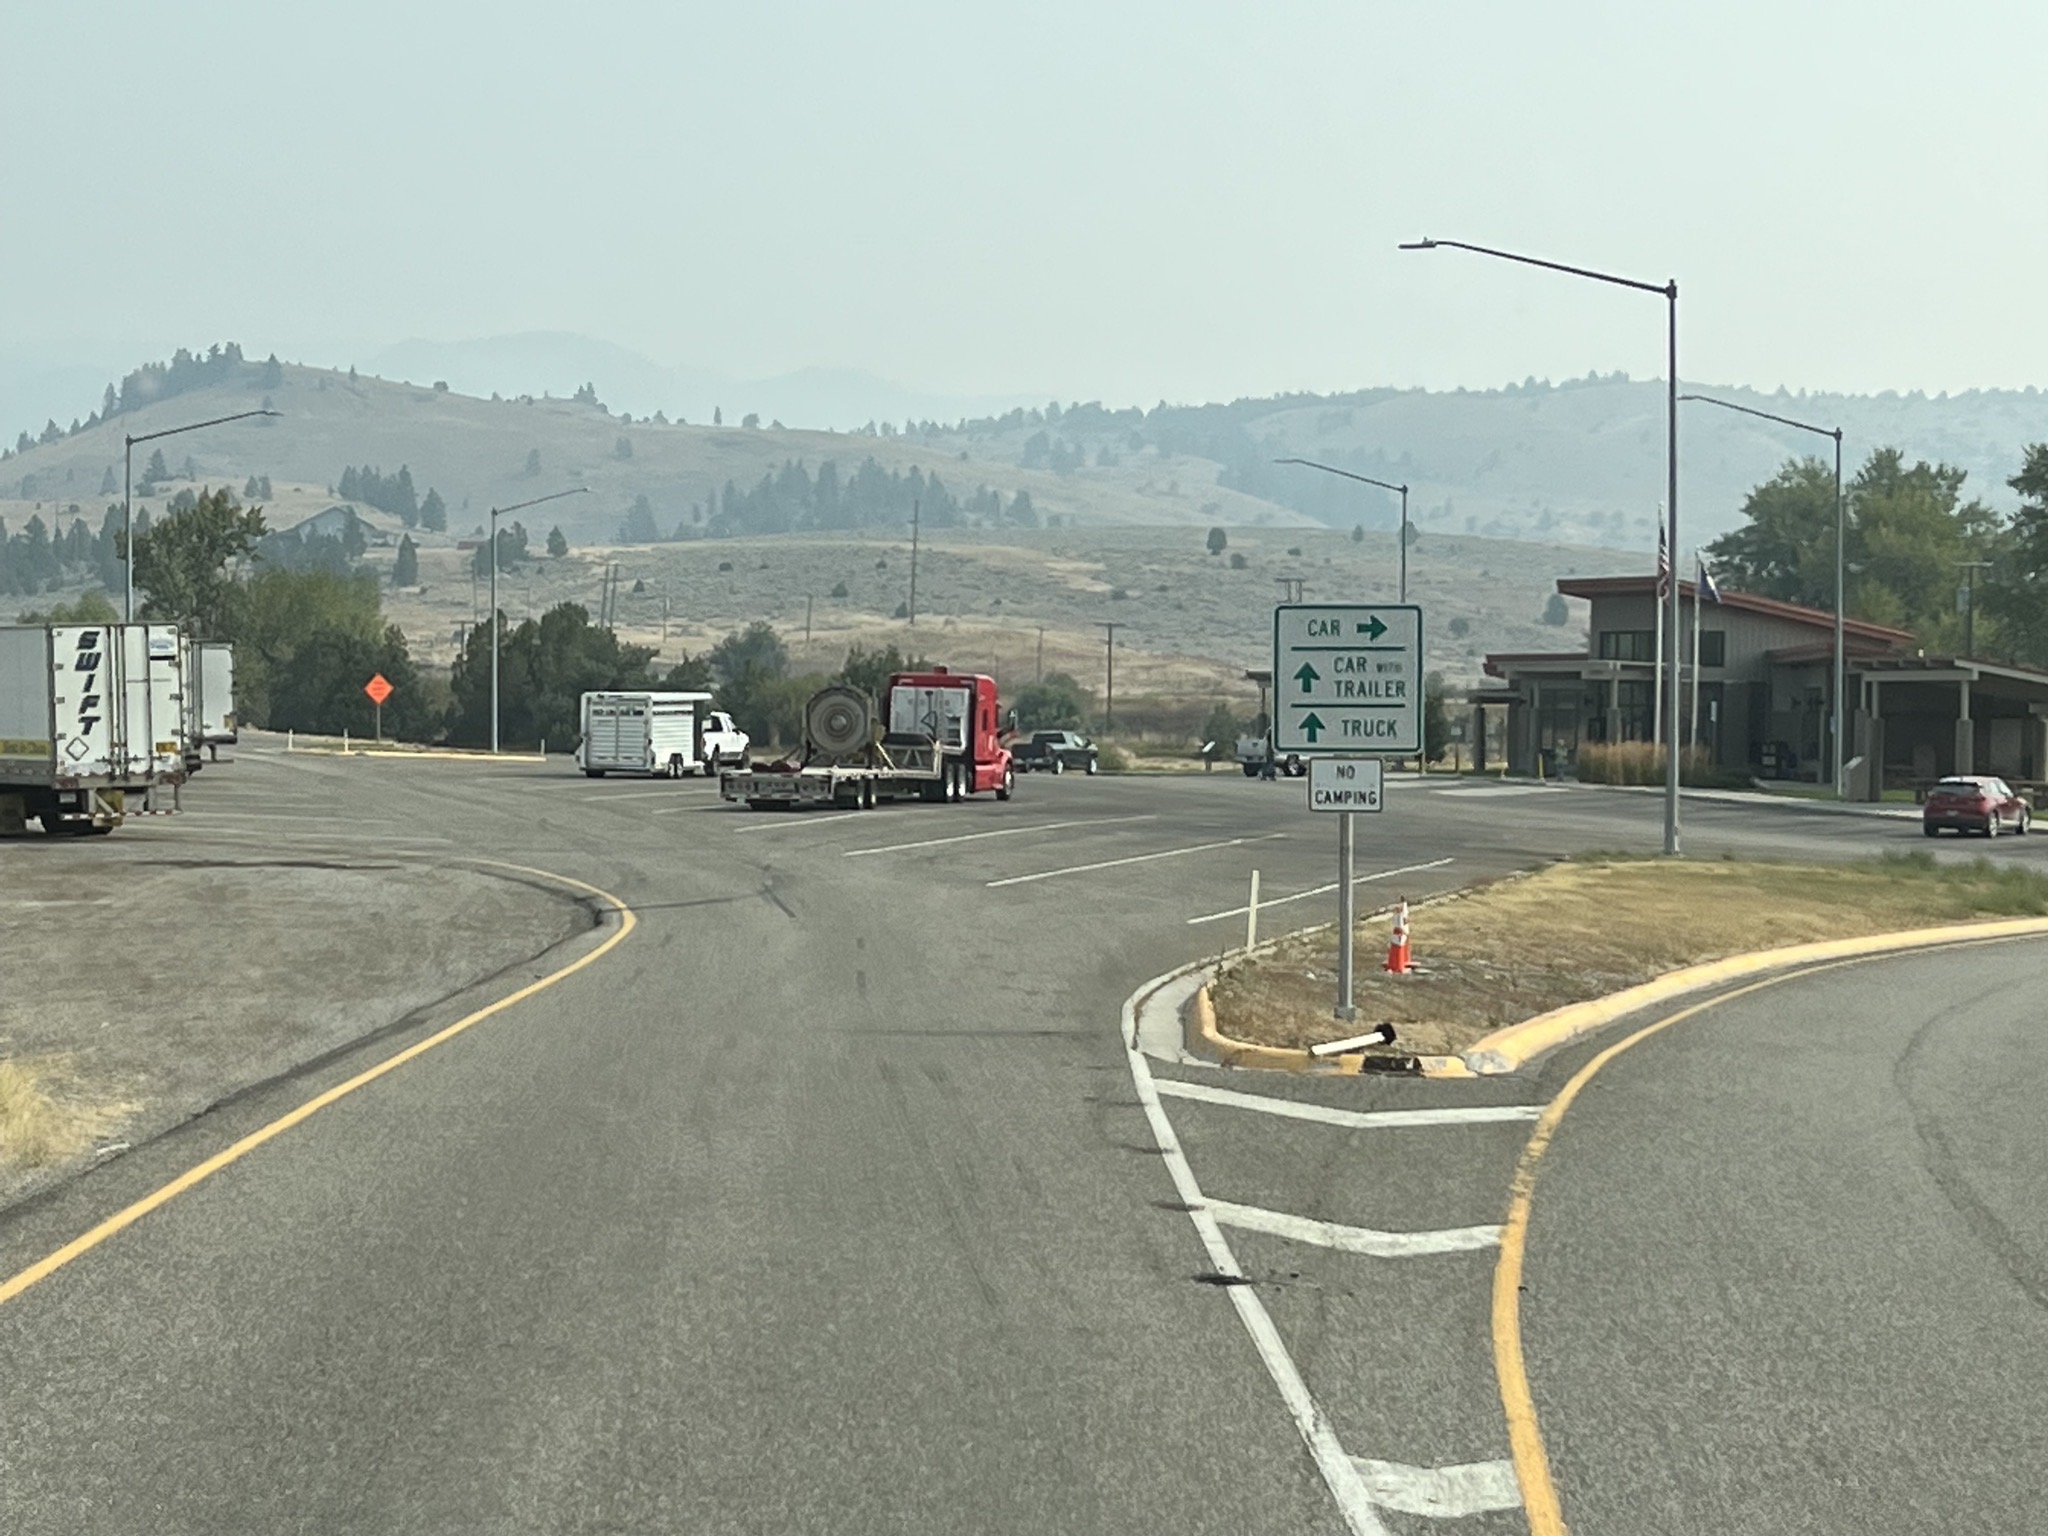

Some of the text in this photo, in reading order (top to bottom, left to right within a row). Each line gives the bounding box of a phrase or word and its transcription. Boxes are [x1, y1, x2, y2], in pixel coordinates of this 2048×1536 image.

[1307, 619, 1341, 637] CAR
[1333, 656, 1367, 673] CAR
[74, 631, 102, 735] SWIFT
[1333, 680, 1406, 698] TRAILER
[1341, 719, 1398, 738] TRUCK
[1336, 765, 1356, 780] NO
[1314, 790, 1377, 805] CAMPING
